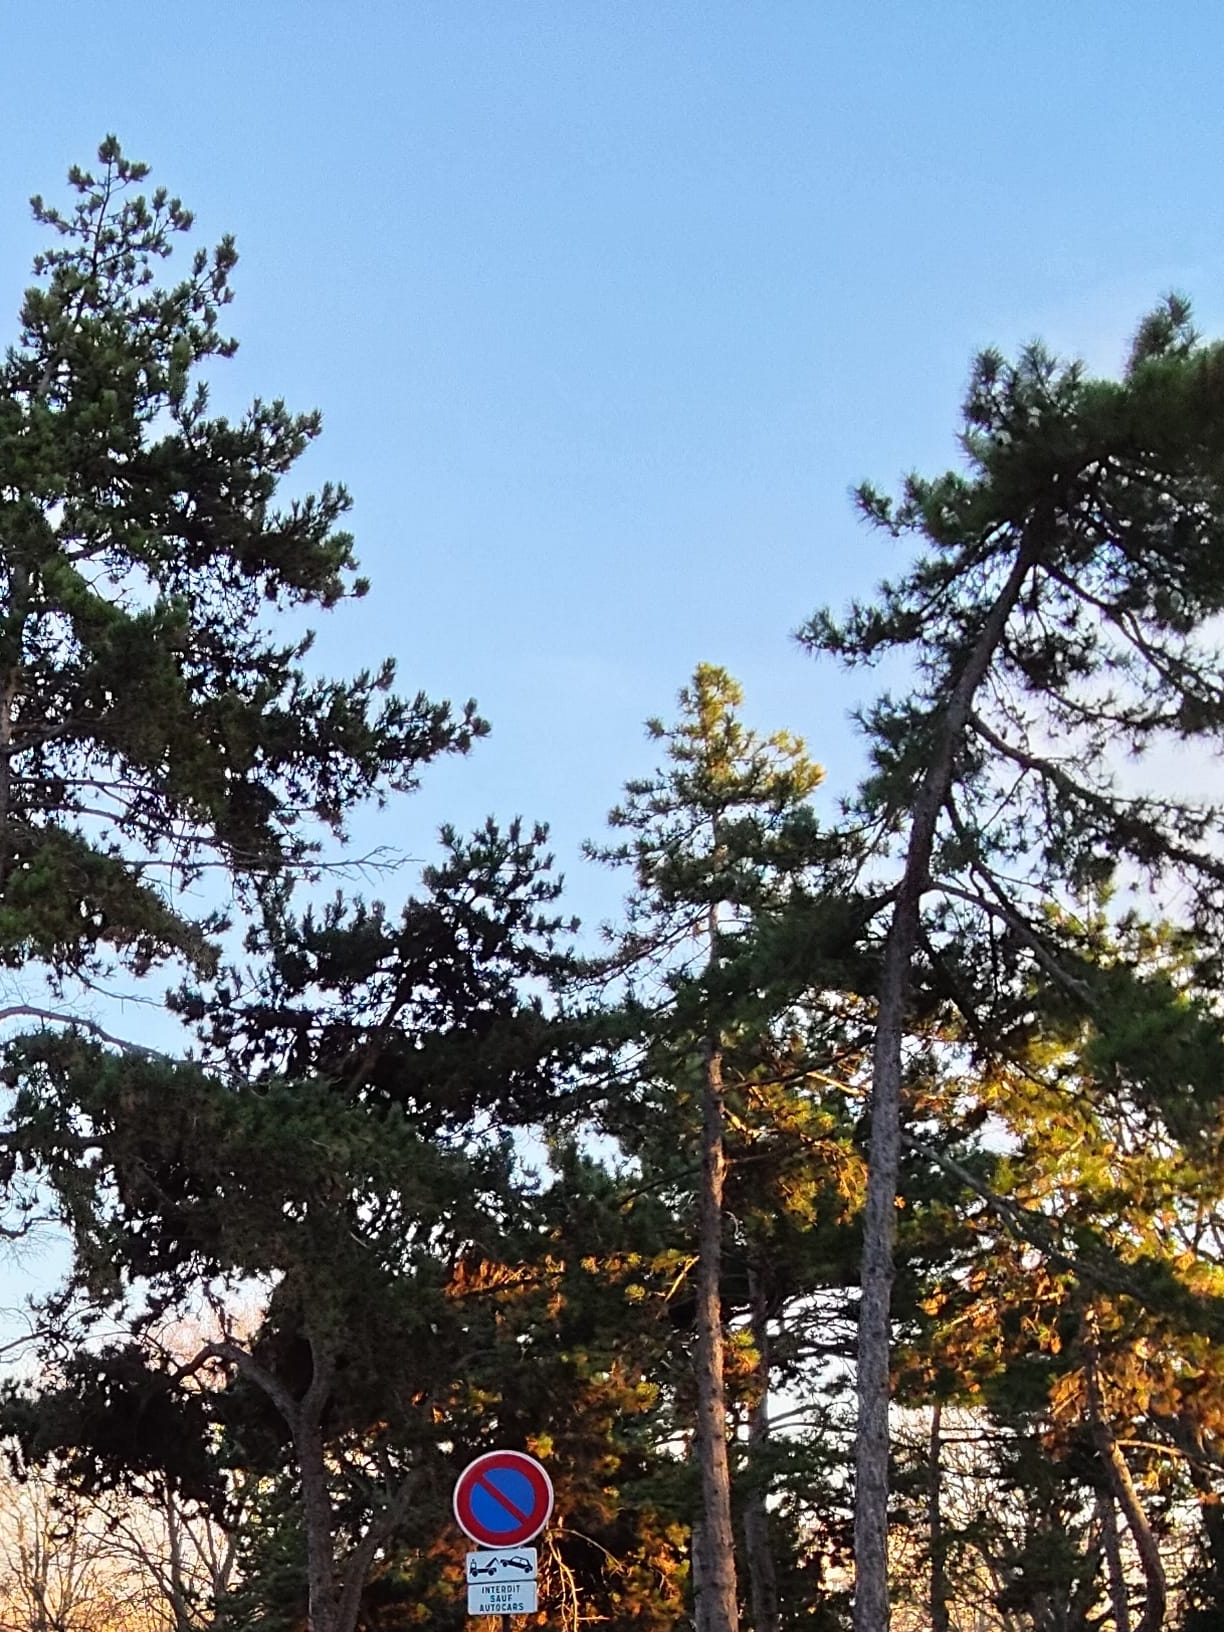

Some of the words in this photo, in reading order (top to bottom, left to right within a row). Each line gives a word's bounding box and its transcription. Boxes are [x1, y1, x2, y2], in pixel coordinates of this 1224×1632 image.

[481, 1585, 520, 1593] INTERDIT
[490, 1594, 513, 1602] SAUF
[479, 1603, 524, 1611] AUTOCARS
